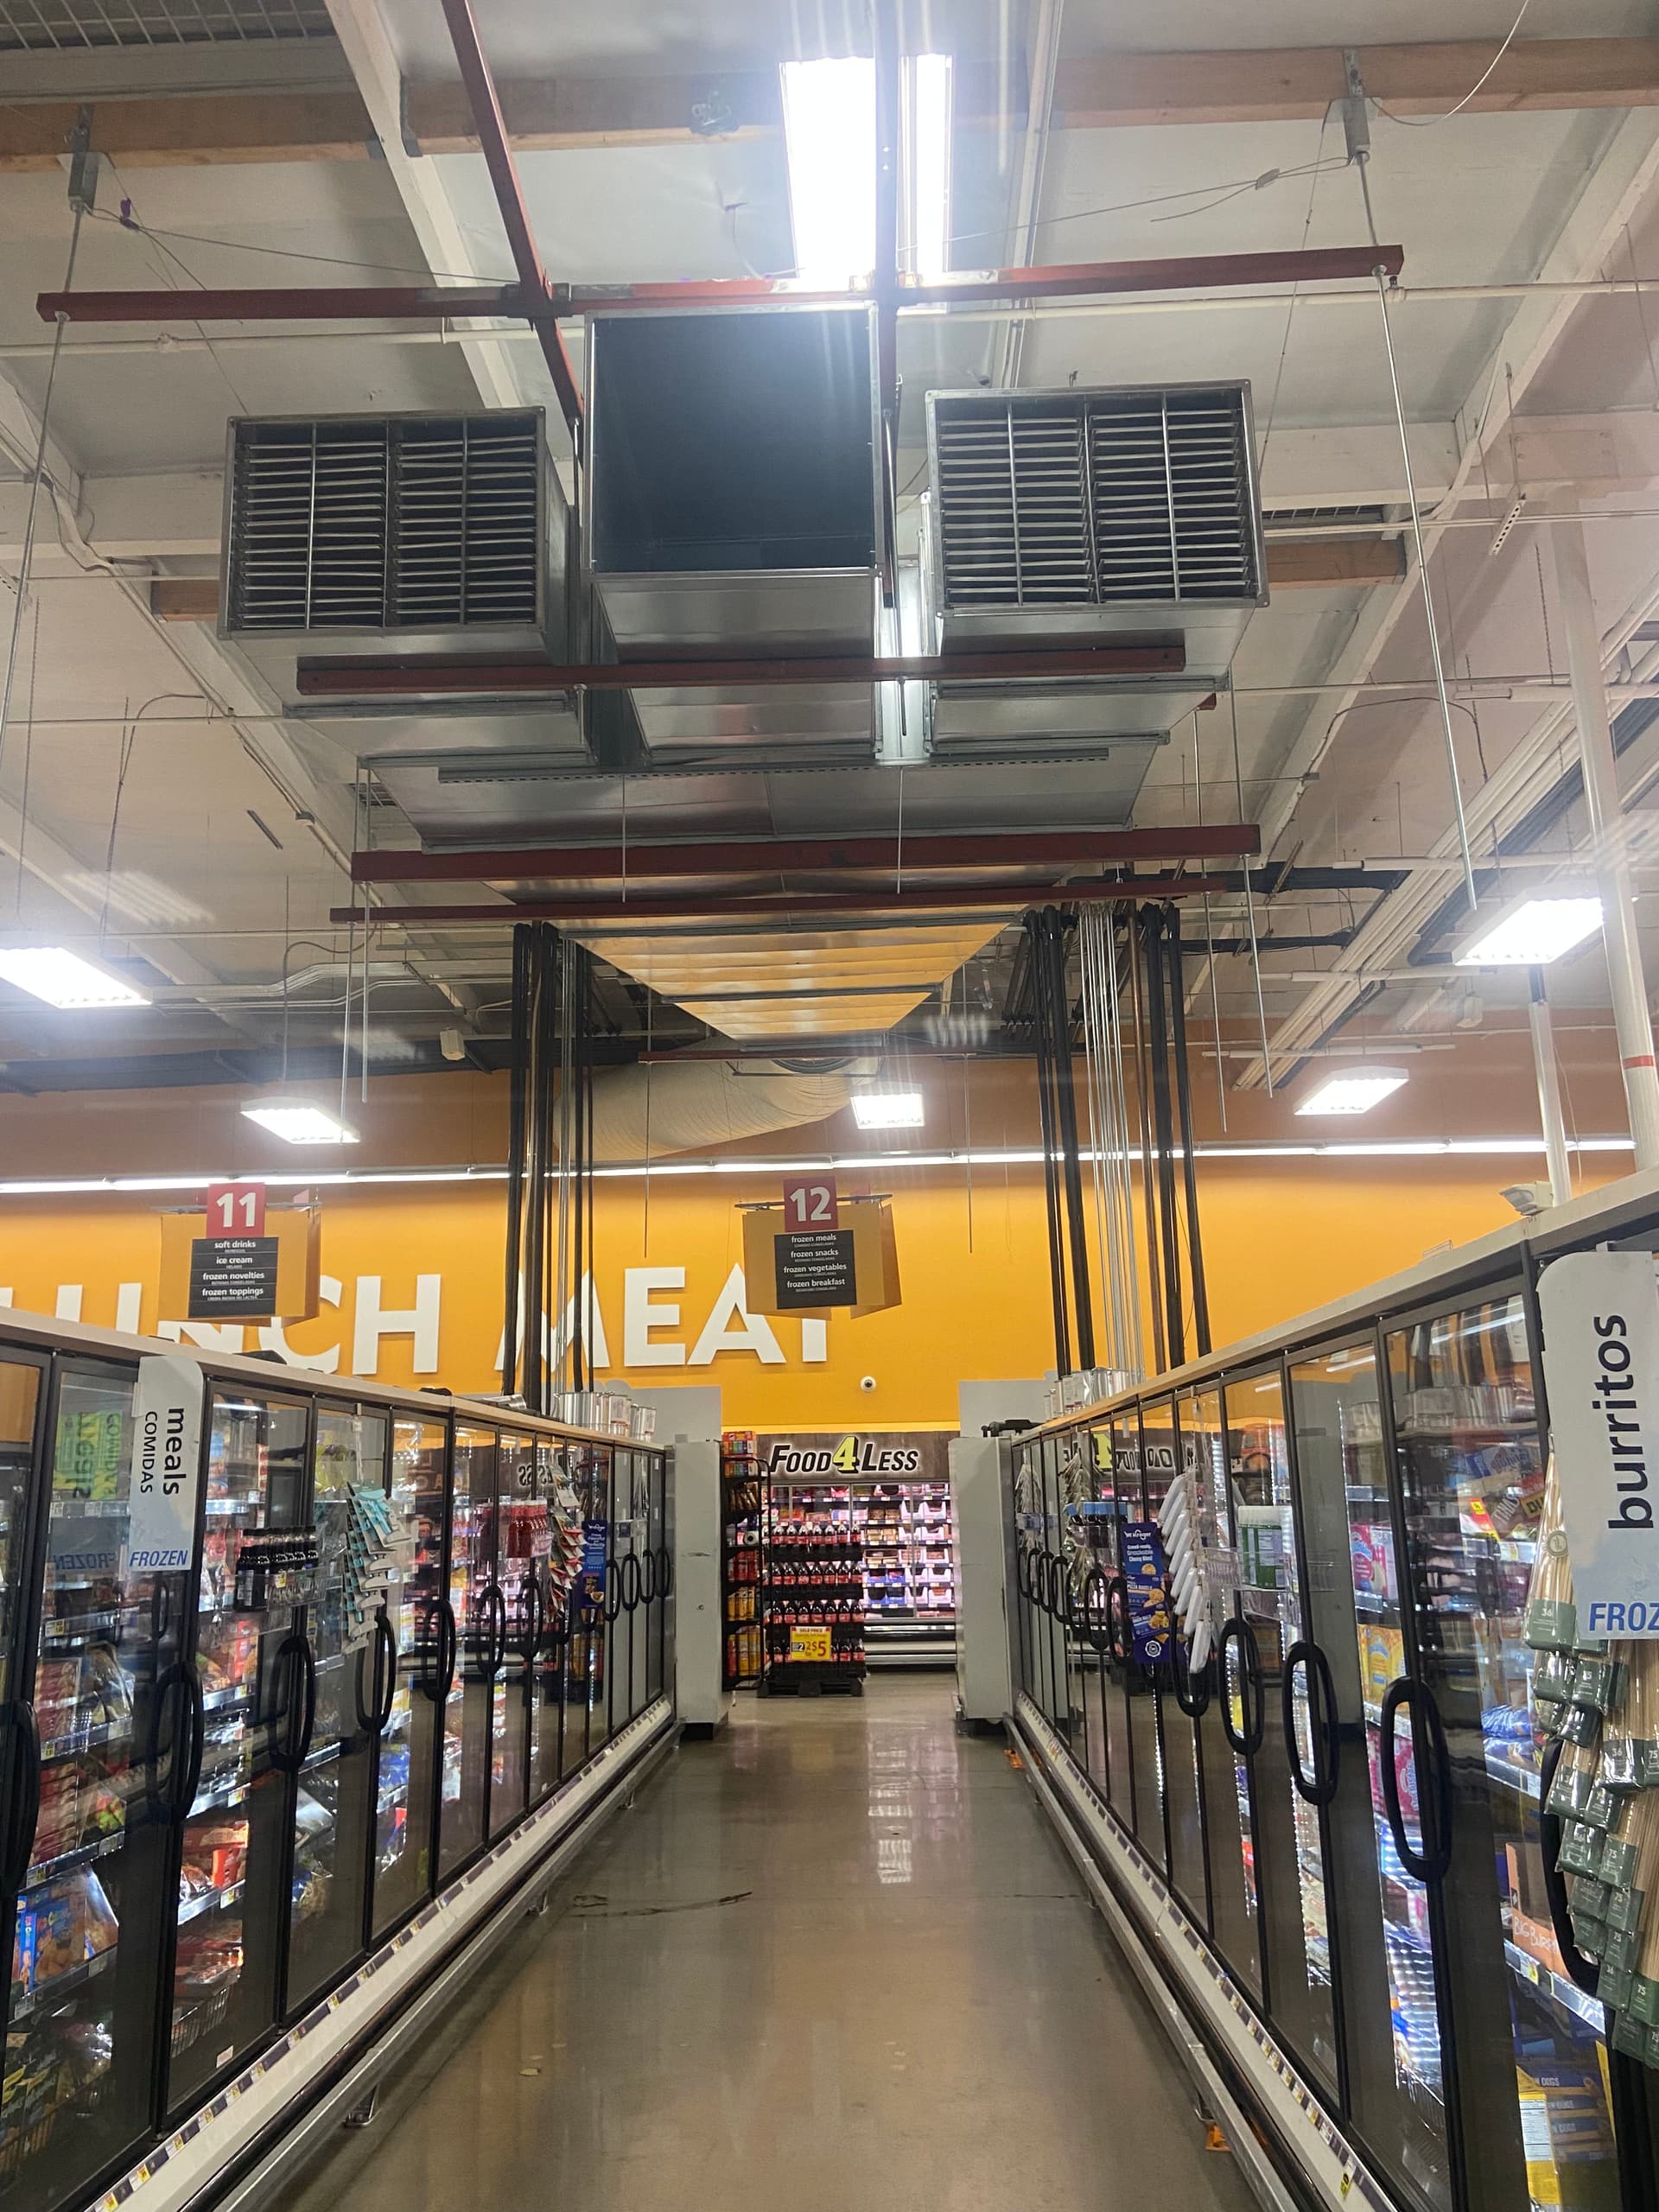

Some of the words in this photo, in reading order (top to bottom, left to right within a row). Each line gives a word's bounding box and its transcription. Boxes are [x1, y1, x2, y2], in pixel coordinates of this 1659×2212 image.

[790, 1186, 832, 1223] 12
[216, 1192, 256, 1228] 11
[816, 1233, 837, 1242] meals
[214, 1240, 231, 1249] soft
[232, 1240, 257, 1249] drinks
[815, 1248, 839, 1256] snacks
[216, 1255, 227, 1264] ice
[808, 1262, 847, 1273] vegetables
[202, 1272, 228, 1281] frozen
[229, 1271, 265, 1280] novelties
[811, 1278, 846, 1287] breakfast
[229, 1287, 264, 1297] toppings
[1592, 1313, 1655, 1529] burritos
[140, 1410, 157, 1494] COMIDAS
[162, 1408, 188, 1496] meals
[832, 1435, 860, 1474] 4
[130, 1549, 188, 1568] FROZEN
[1541, 1608, 1553, 1617] 36
[1611, 1748, 1623, 1757] 36
[1649, 1750, 1658, 1759] 75
[1608, 1848, 1618, 1859] 75
[1614, 1892, 1624, 1902] 75
[1613, 1932, 1622, 1942] 75
[1637, 1984, 1646, 1995] 75
